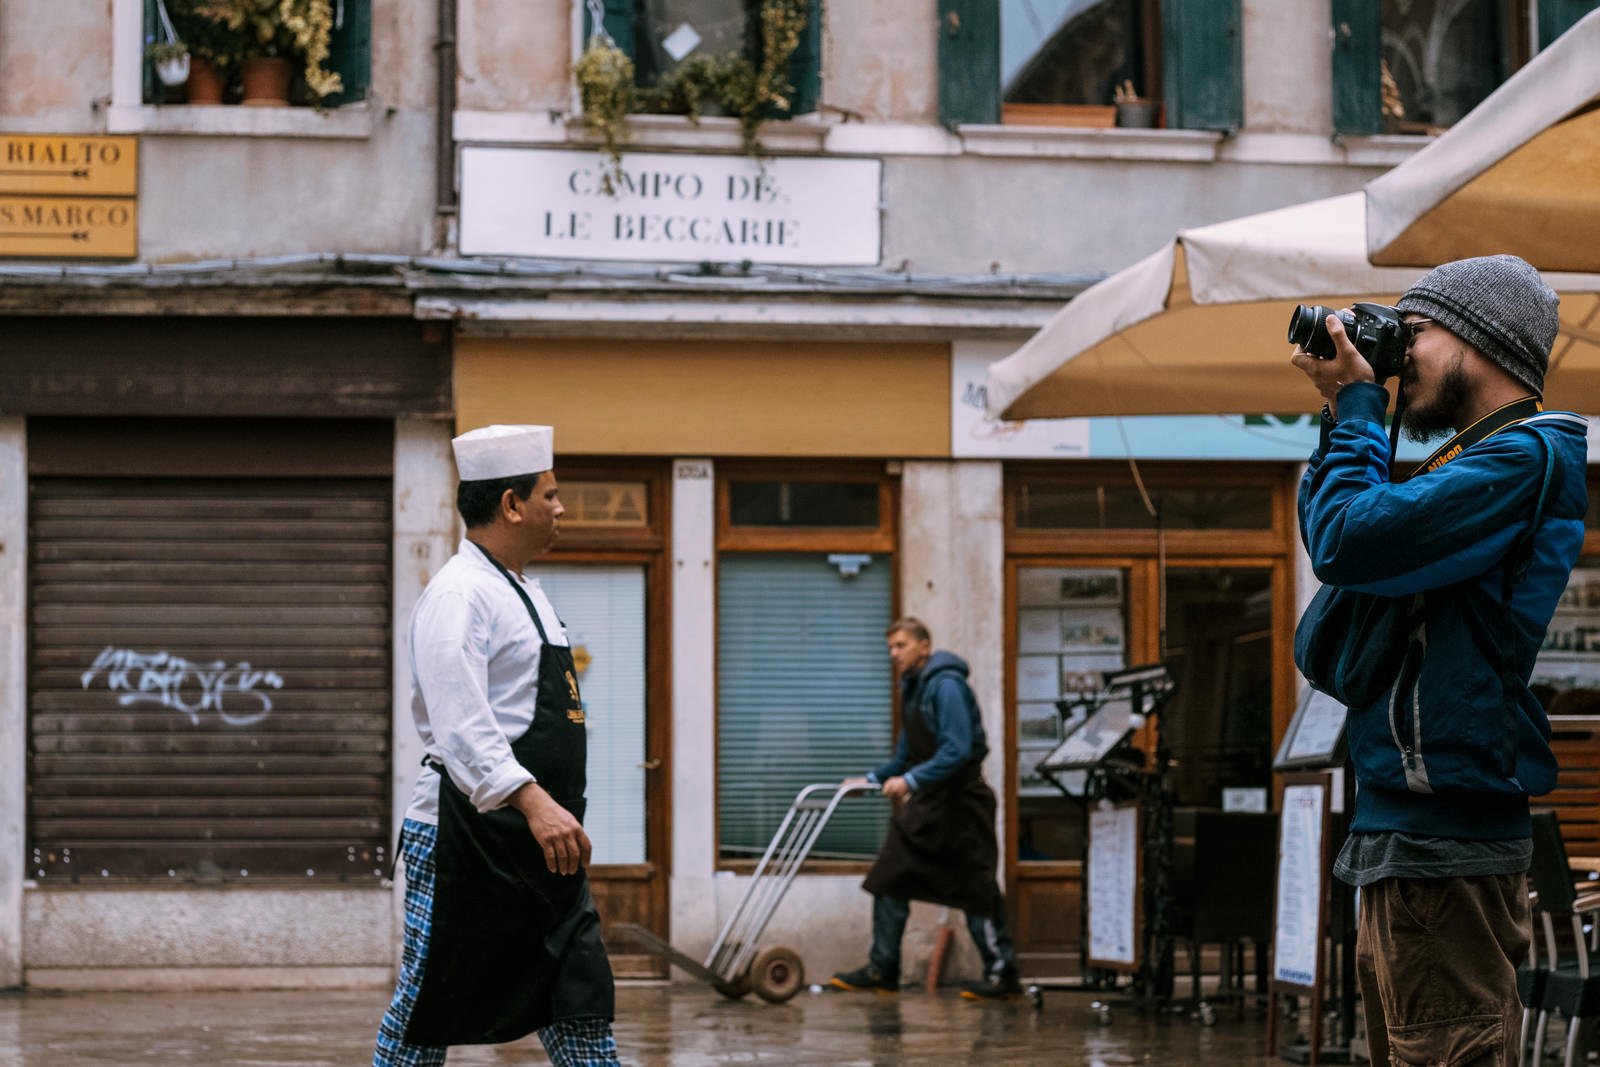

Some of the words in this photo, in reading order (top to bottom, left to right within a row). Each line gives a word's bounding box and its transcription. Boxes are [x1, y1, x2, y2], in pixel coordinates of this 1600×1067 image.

[7, 142, 121, 165] RIALTO
[545, 210, 592, 239] LE
[613, 213, 801, 247] BECCARIE
[1427, 443, 1463, 472] Nikon
